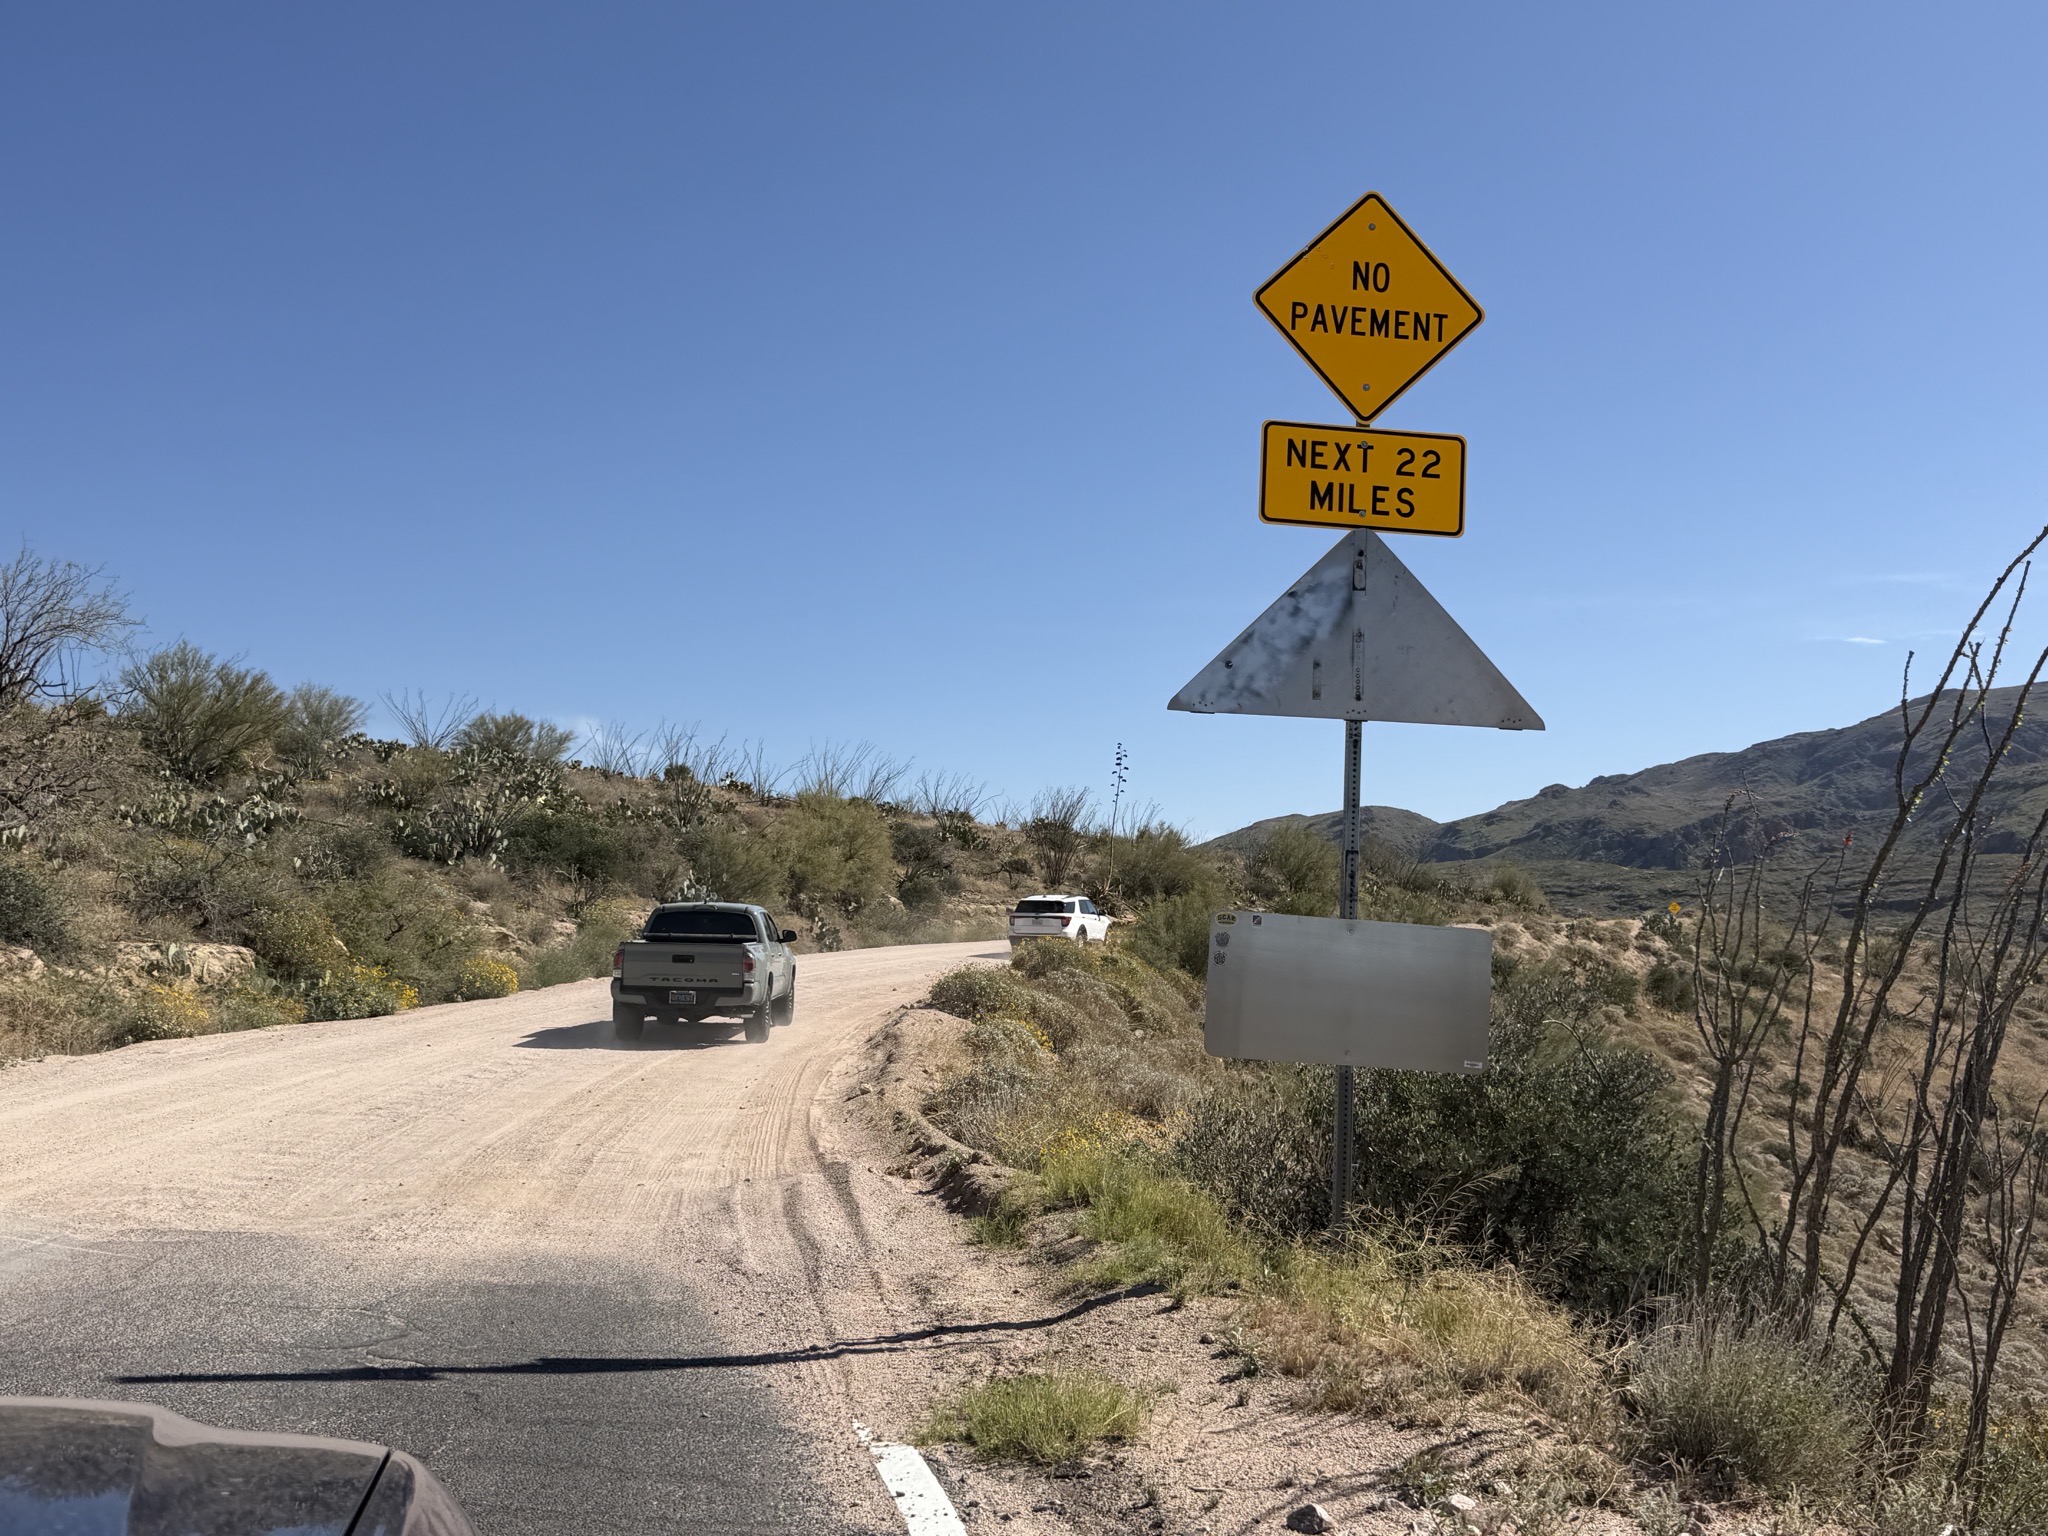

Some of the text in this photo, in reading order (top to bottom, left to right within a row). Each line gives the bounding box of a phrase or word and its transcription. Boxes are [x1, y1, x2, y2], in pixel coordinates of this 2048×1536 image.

[1352, 261, 1390, 293] NO
[1290, 301, 1449, 342] PAVEMENT
[1286, 438, 1441, 479] NEXT 22
[1309, 480, 1415, 518] MILES
